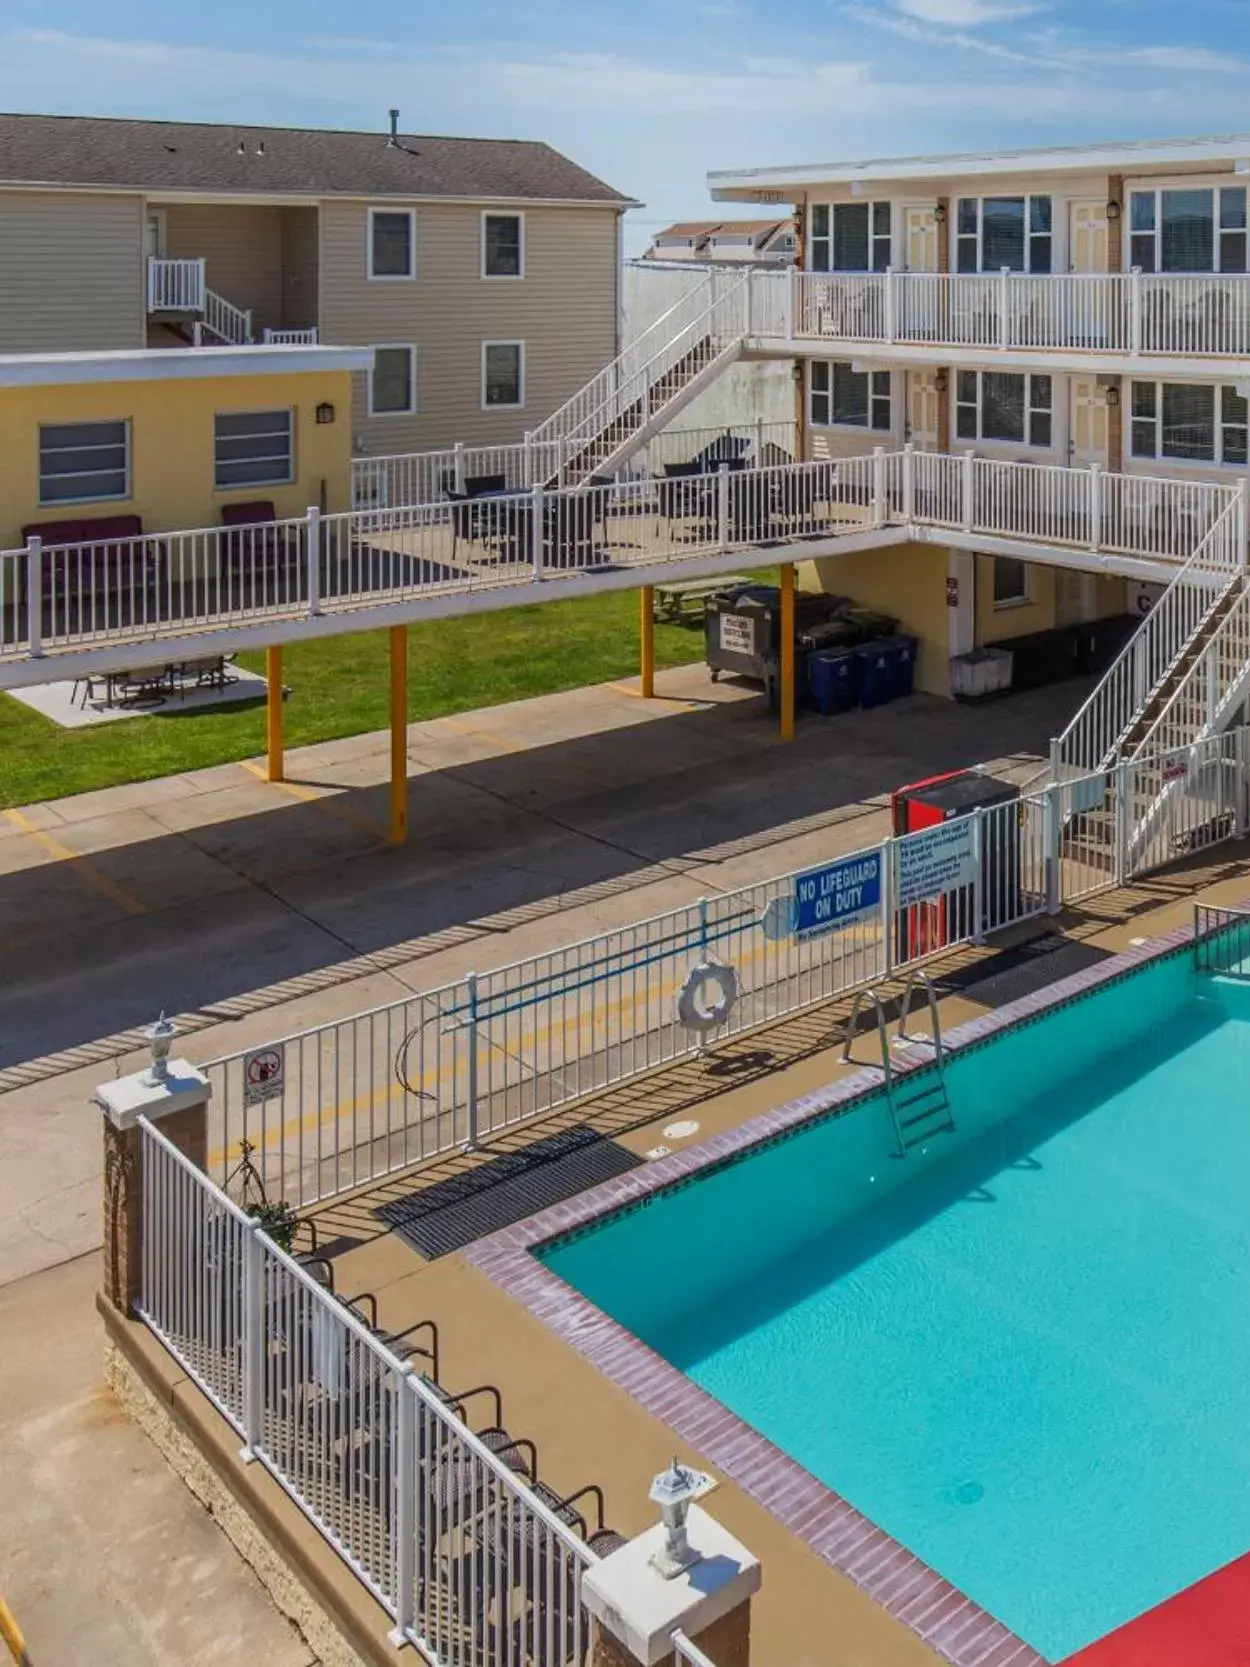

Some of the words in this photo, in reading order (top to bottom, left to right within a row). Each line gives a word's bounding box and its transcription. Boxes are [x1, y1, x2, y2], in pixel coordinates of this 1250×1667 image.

[800, 880, 815, 902] NO
[821, 860, 877, 896] LIFEGUARD
[816, 896, 831, 919] ON
[836, 885, 863, 911] DUTY
